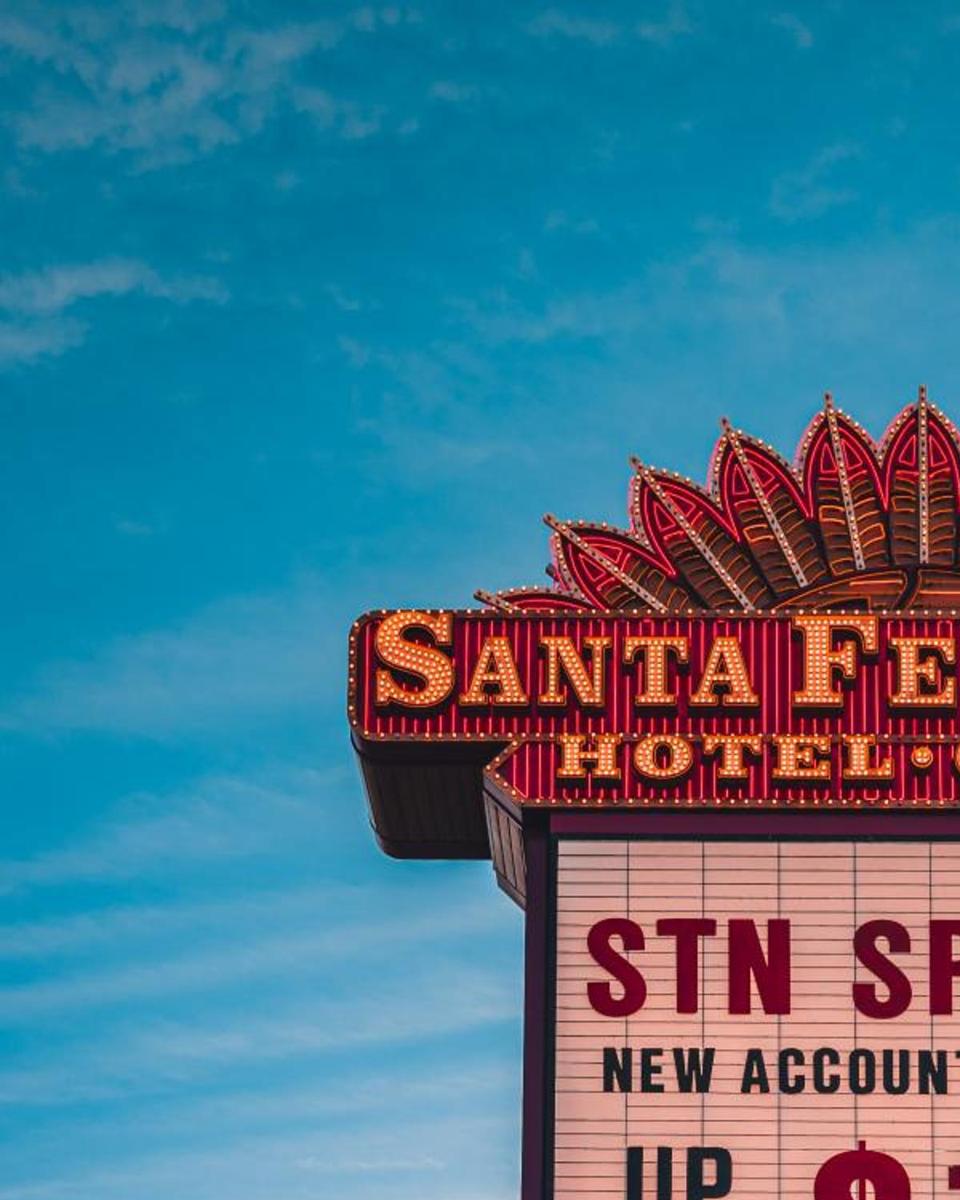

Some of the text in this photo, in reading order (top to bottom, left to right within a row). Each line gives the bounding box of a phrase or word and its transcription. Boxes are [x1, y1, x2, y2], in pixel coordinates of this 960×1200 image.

[374, 611, 762, 708] SANTA
[792, 615, 957, 707] FE
[555, 734, 896, 780] HOTEL
[586, 918, 791, 1018] STN
[603, 1048, 714, 1093] NEW
